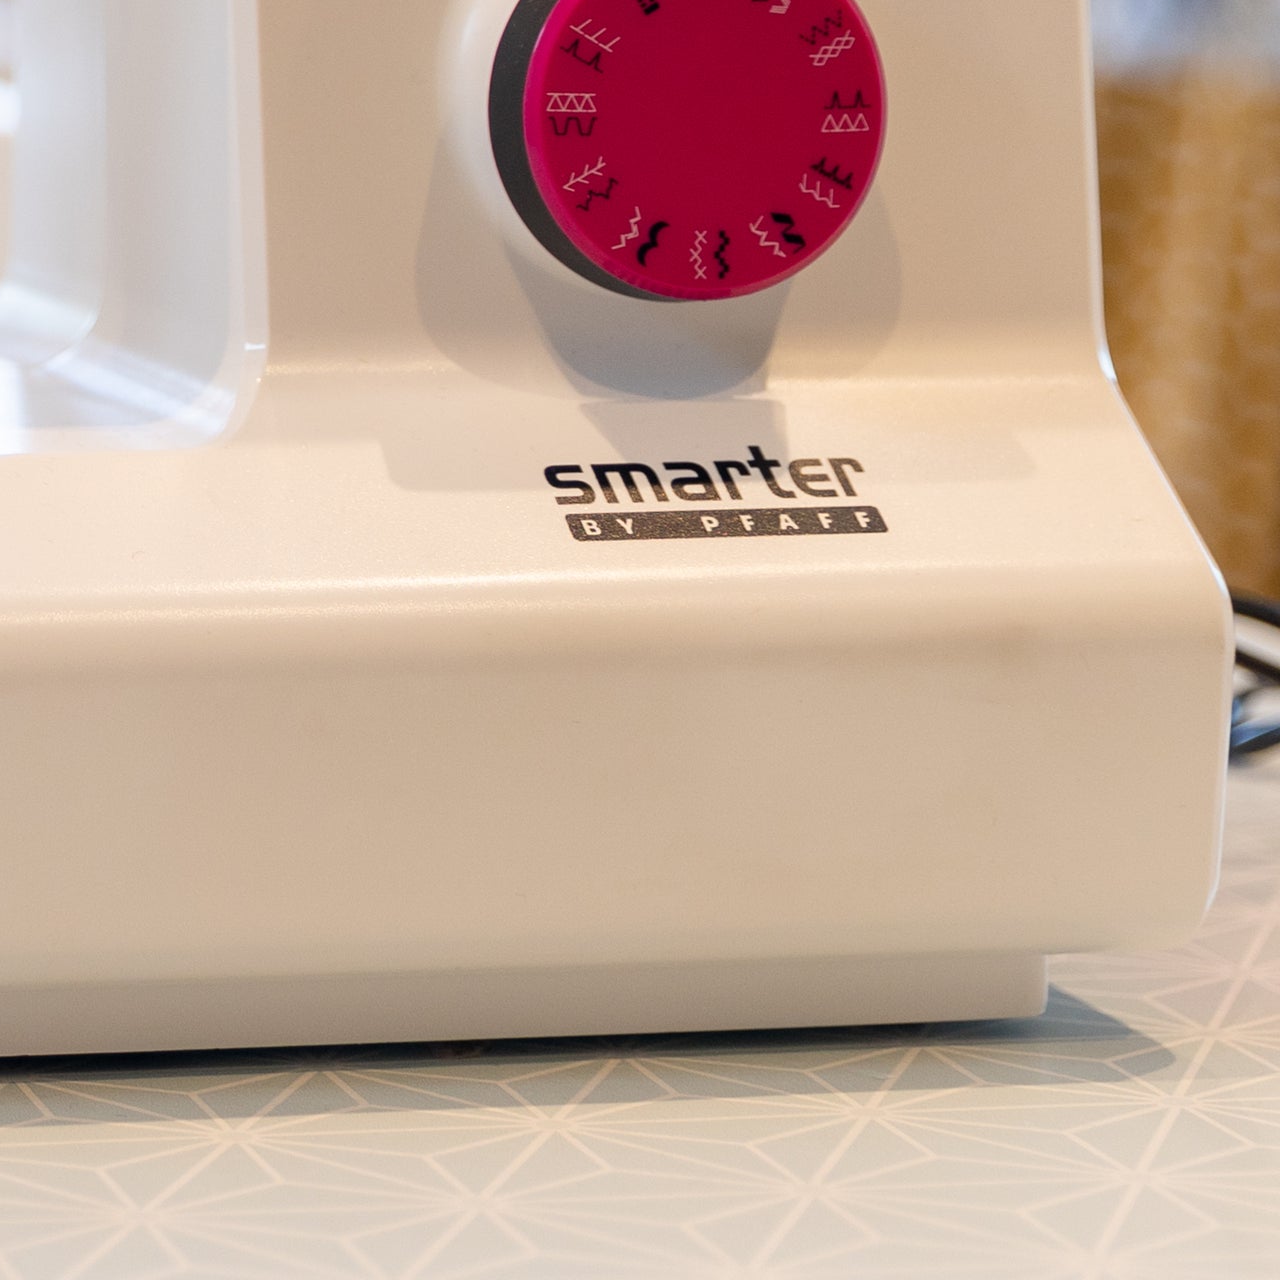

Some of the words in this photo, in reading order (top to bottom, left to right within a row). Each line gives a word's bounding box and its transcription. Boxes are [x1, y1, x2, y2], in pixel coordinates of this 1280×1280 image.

[544, 445, 866, 505] smarter
[580, 517, 634, 536] BY
[701, 511, 872, 533] PFAFF
